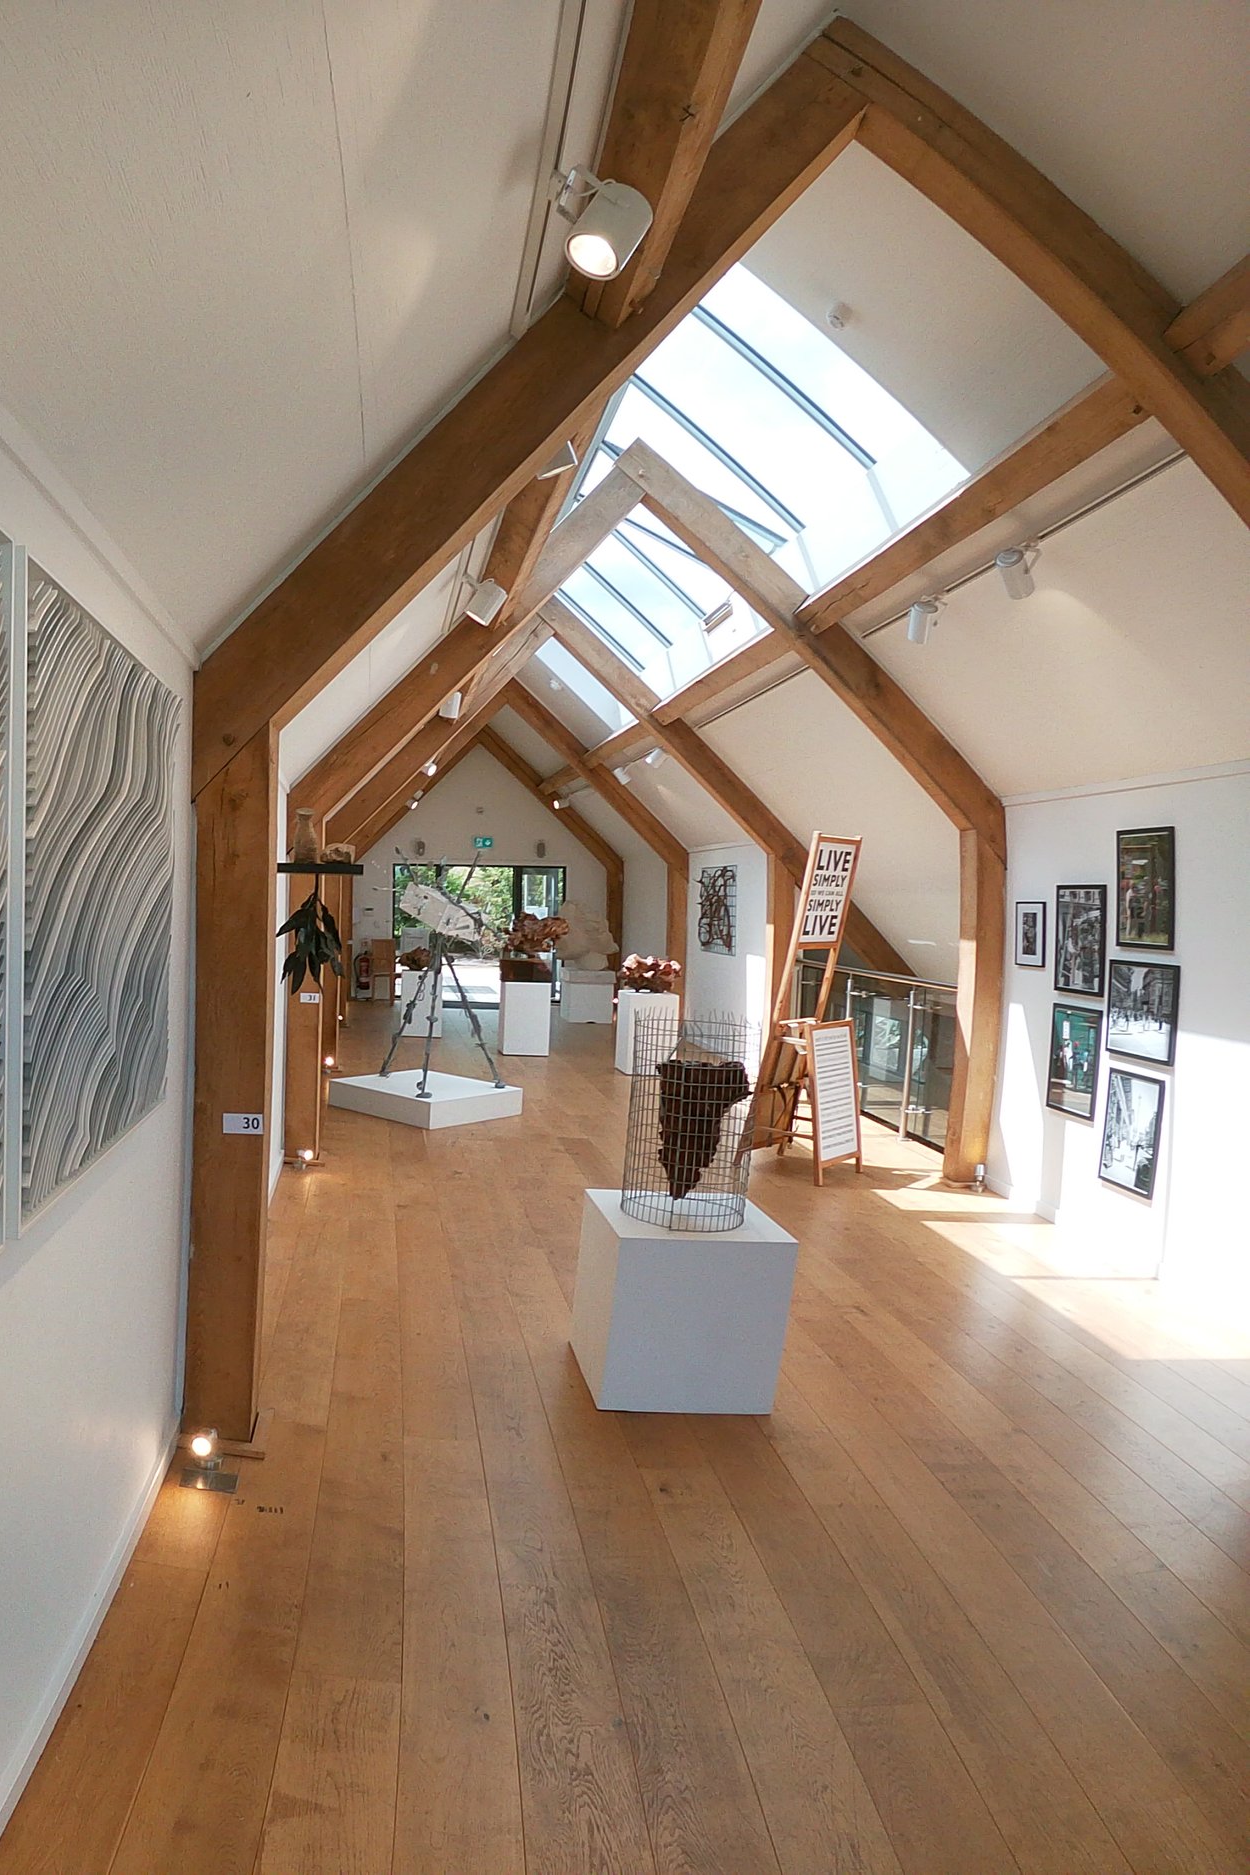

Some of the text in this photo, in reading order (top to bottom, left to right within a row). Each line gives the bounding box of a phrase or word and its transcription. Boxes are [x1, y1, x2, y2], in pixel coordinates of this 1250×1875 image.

[816, 849, 852, 872] LIVE
[812, 873, 847, 888] SIMPLY
[807, 899, 842, 912] SIMPLY
[802, 914, 838, 936] LIVE
[242, 1117, 260, 1129] 30
